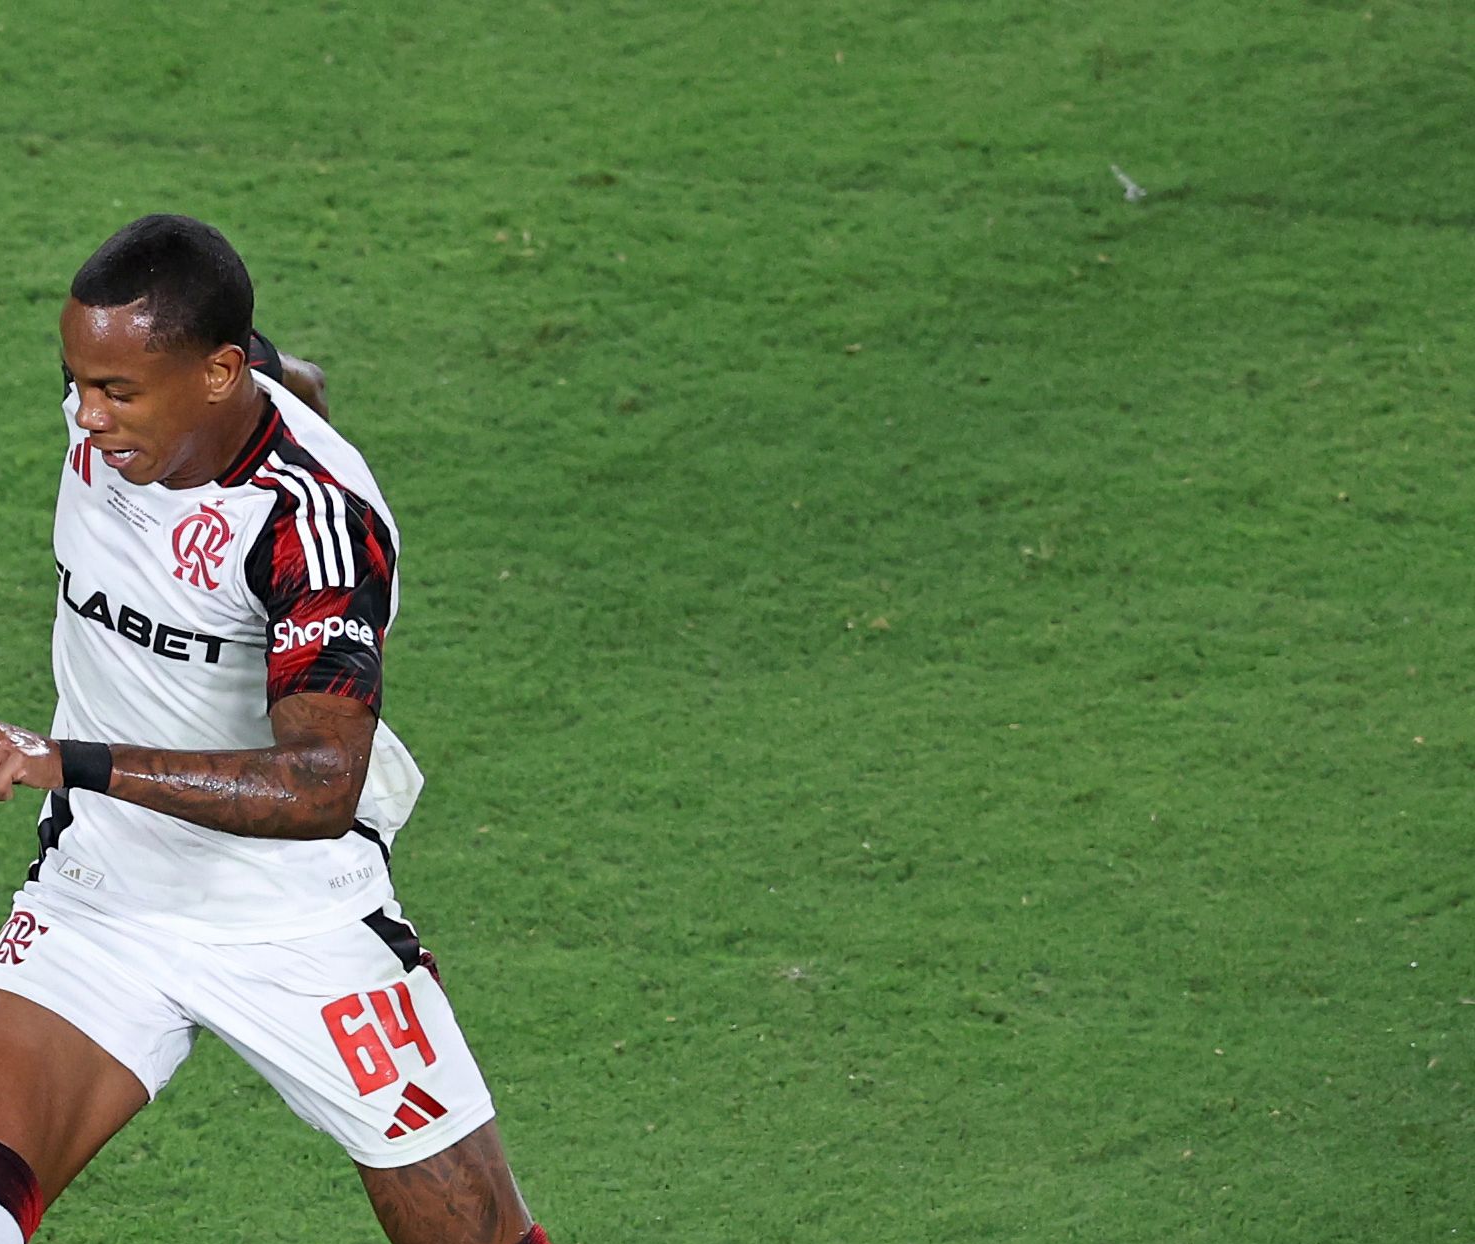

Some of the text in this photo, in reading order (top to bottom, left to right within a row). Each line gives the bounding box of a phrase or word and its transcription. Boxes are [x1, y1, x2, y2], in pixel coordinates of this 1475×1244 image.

[272, 616, 374, 653] Shopee
[328, 864, 374, 889] HEAT RDY
[320, 981, 437, 1097] 64
